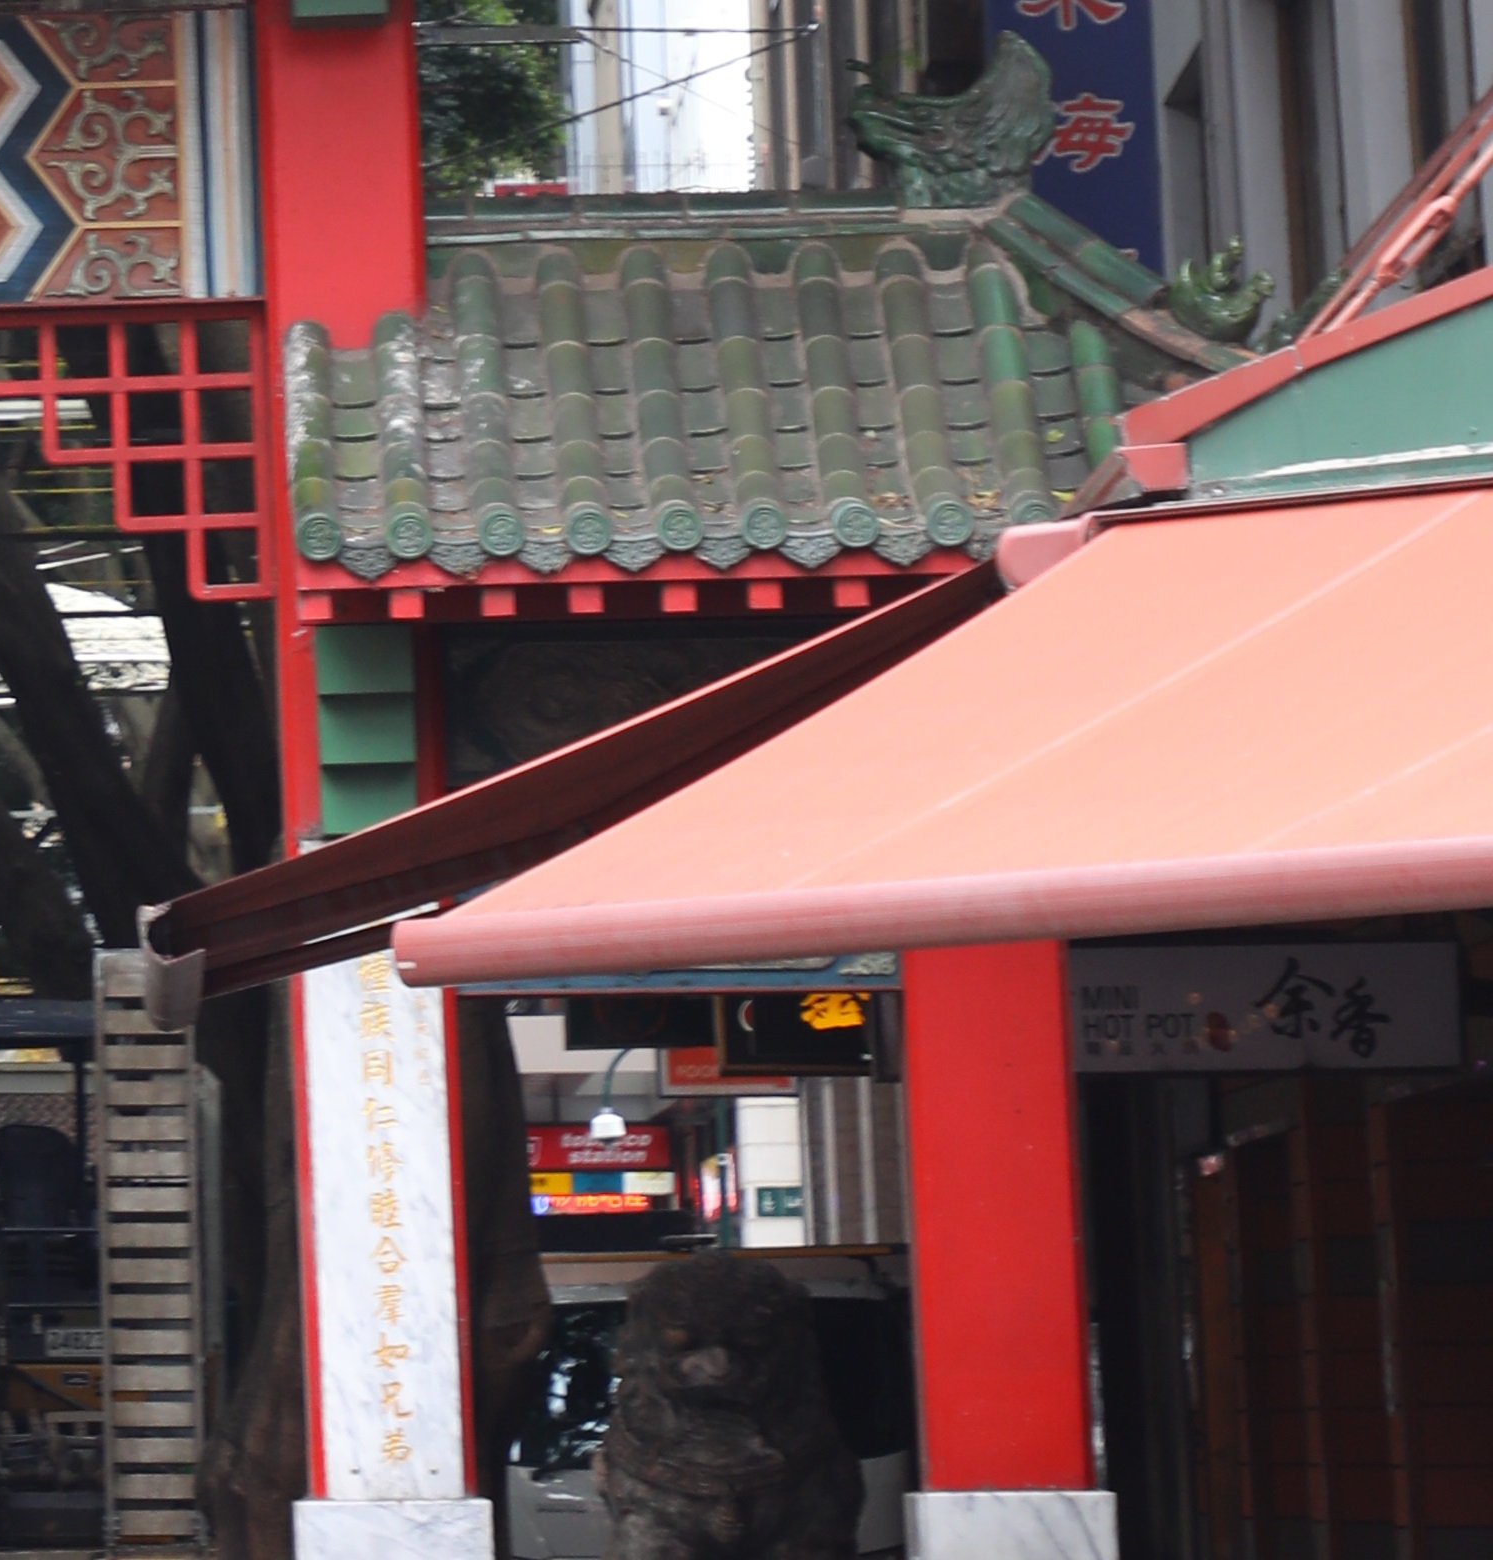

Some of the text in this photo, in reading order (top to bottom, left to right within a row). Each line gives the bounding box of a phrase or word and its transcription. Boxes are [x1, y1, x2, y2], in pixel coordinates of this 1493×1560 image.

[1081, 986, 1139, 1011] MINI
[1084, 1012, 1196, 1040] HOT POT
[567, 1147, 648, 1165] station
